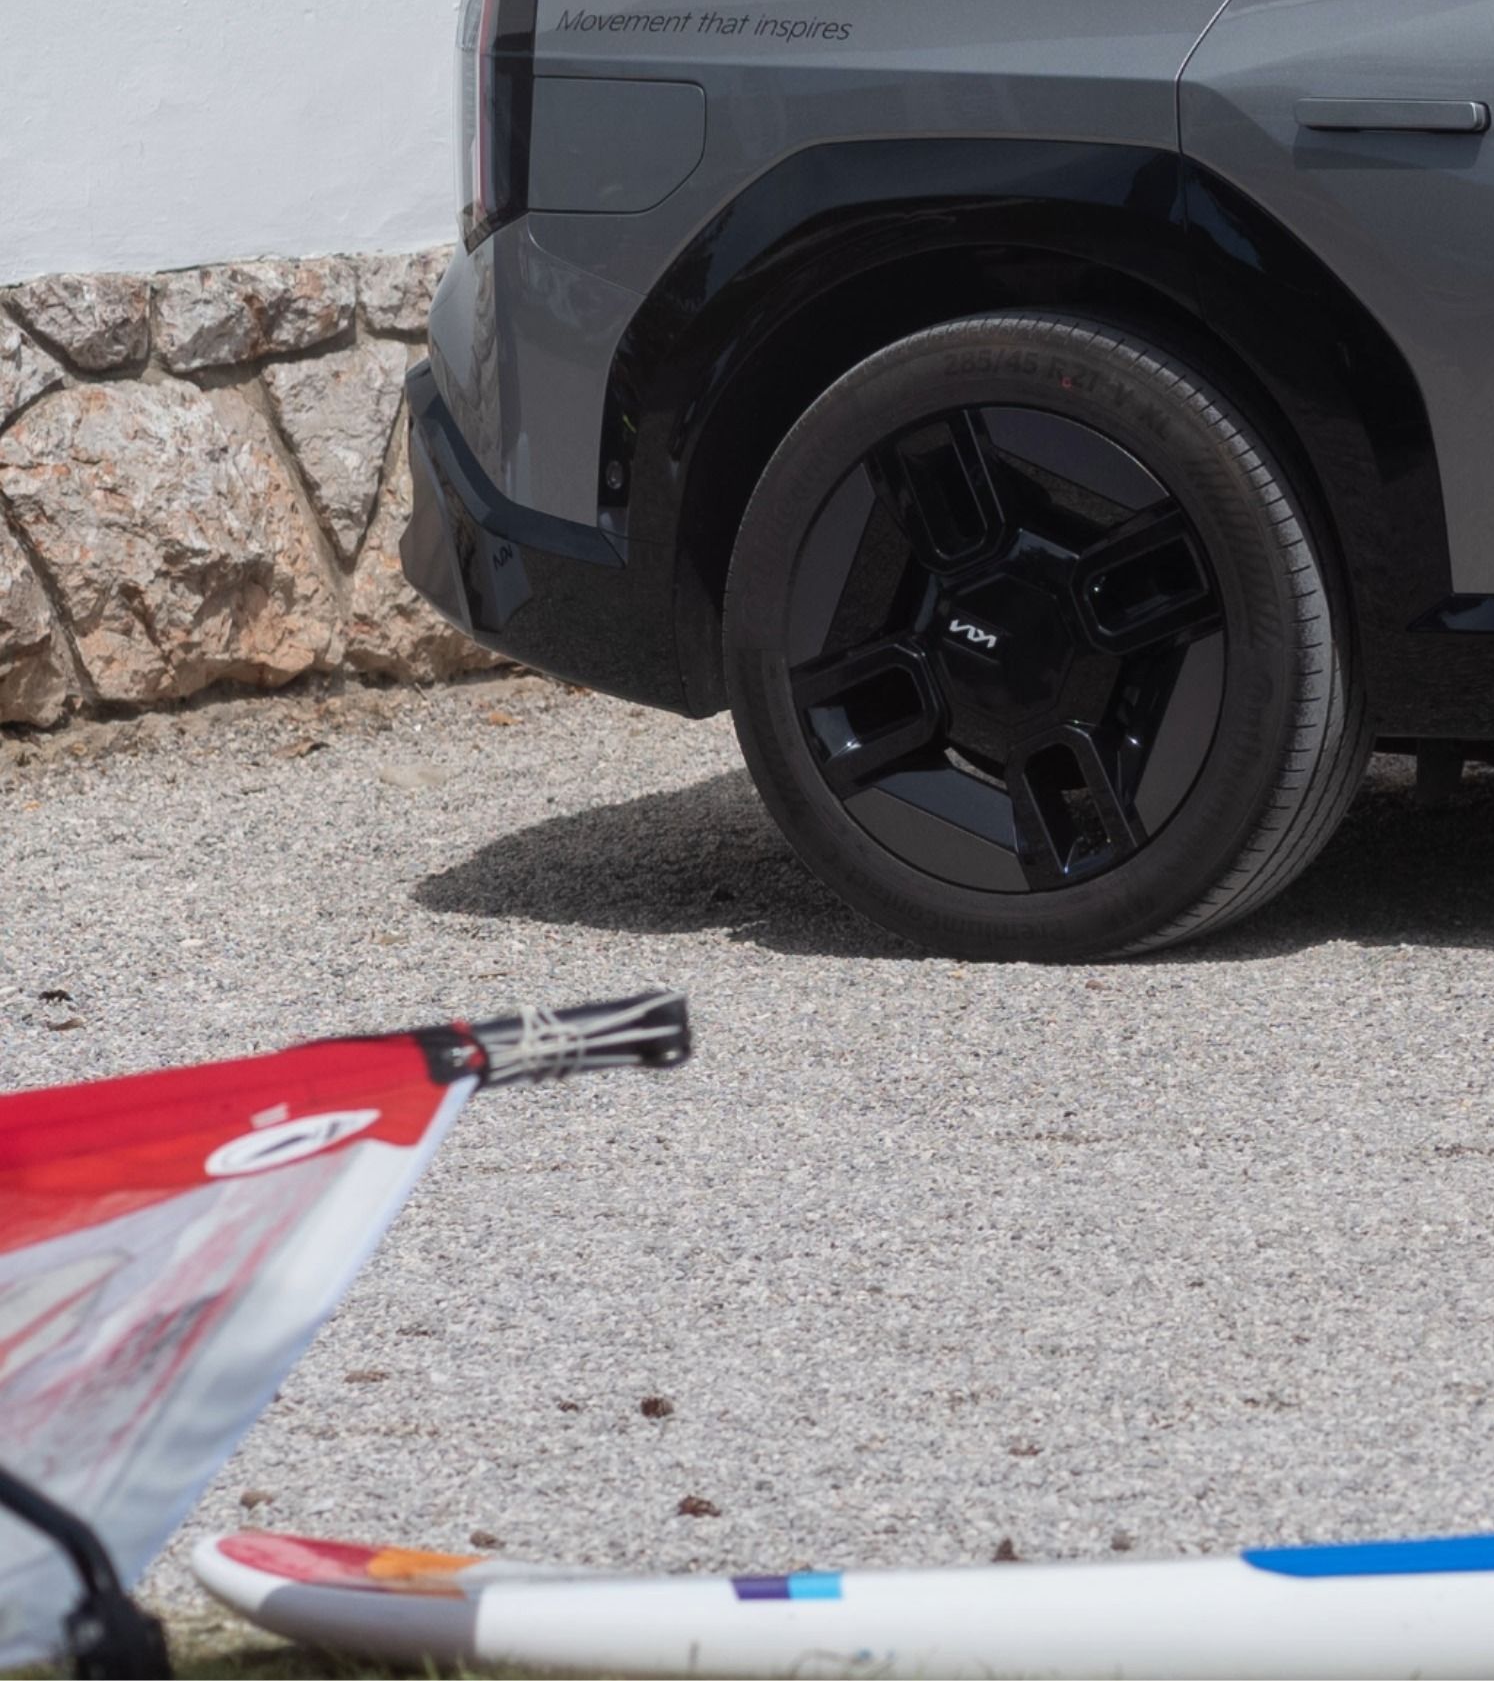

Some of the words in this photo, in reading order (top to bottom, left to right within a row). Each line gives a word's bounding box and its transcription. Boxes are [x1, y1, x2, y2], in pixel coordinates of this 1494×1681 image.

[555, 9, 692, 33] Movement
[697, 11, 749, 36] that
[754, 14, 853, 43] inspires
